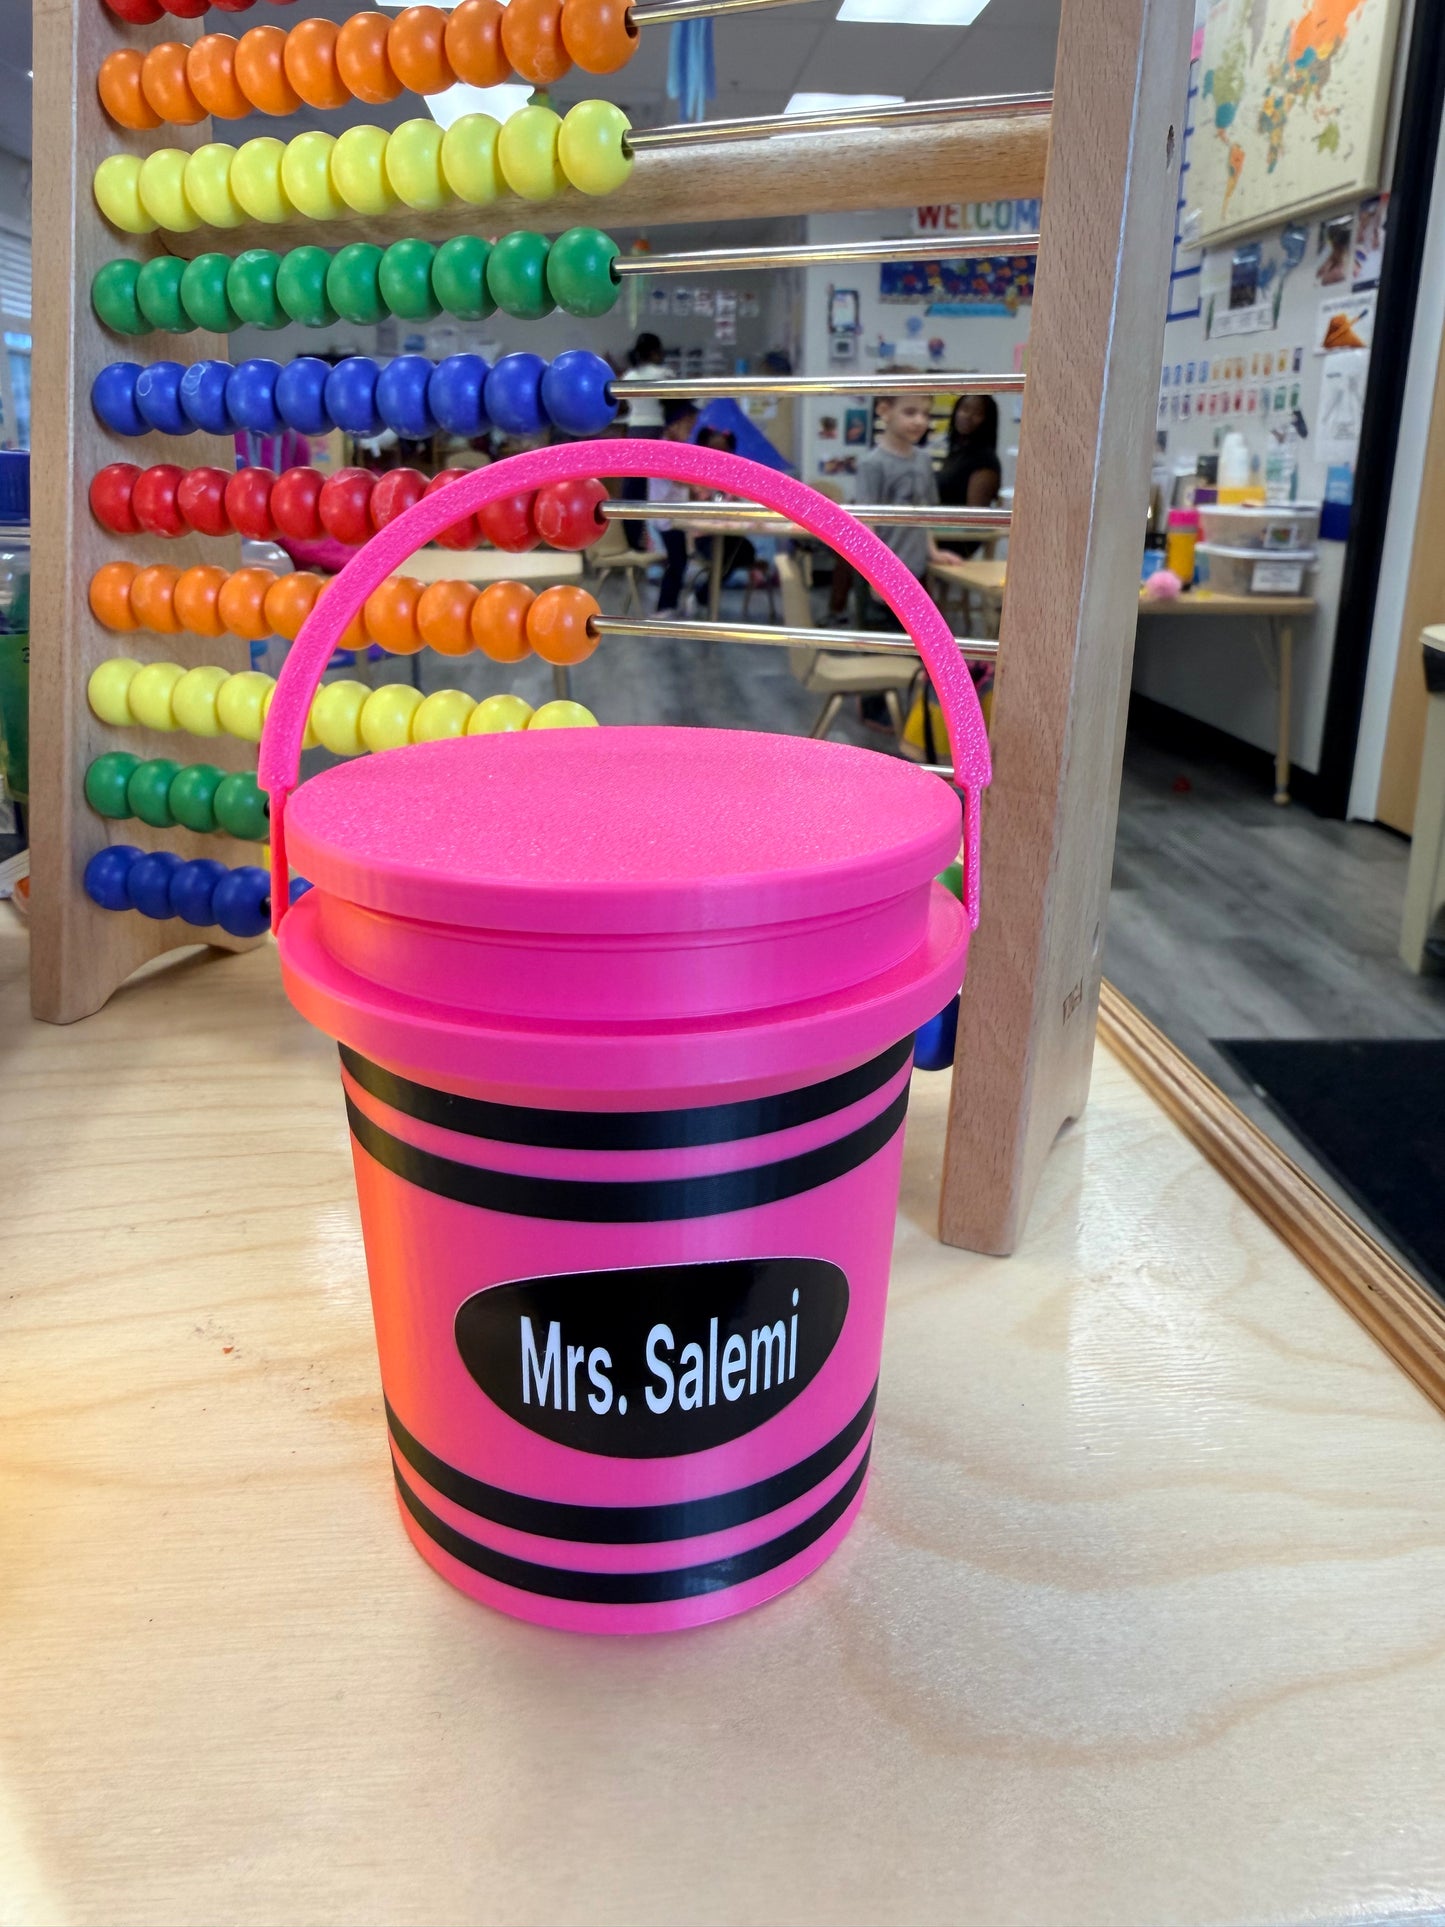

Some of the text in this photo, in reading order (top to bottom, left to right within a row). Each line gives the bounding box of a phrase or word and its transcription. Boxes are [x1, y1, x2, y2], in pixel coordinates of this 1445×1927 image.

[917, 200, 1040, 230] WELCOM
[520, 1288, 801, 1416] Mrs. Salemi
